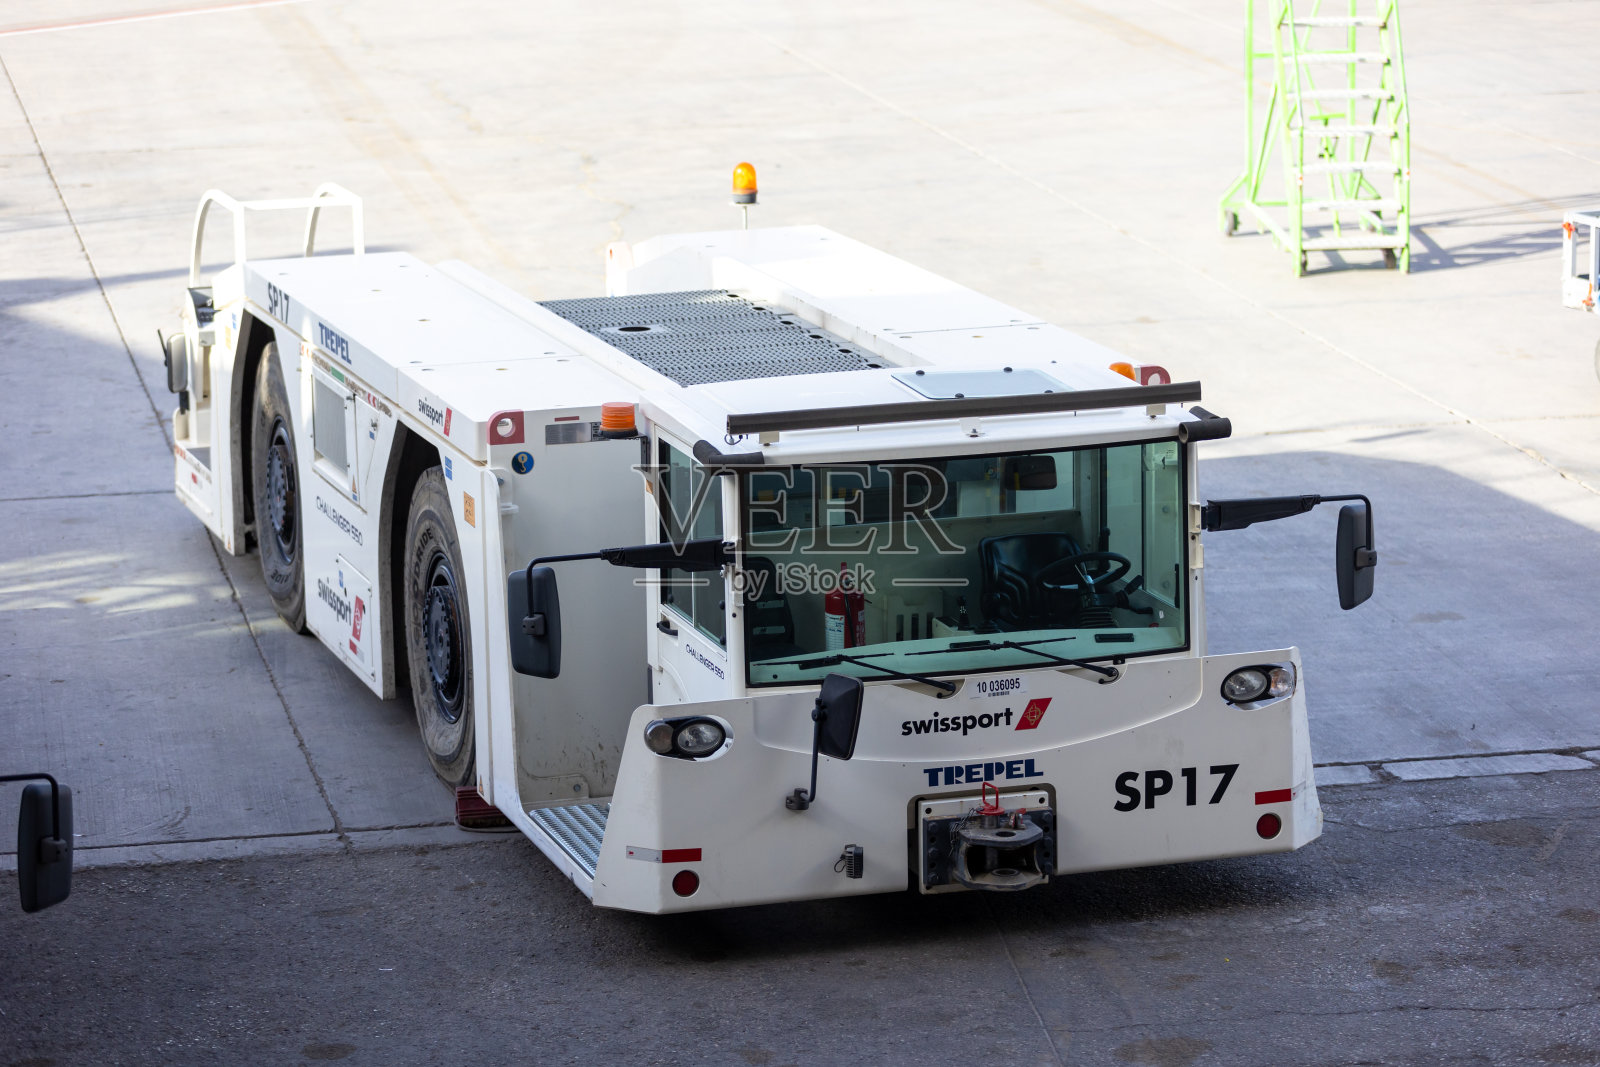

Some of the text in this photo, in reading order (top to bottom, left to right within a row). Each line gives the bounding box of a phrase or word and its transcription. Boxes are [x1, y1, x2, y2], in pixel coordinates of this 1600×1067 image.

[267, 281, 290, 325] SP17
[318, 321, 352, 365] TREPEL
[418, 397, 444, 427] swissport
[316, 495, 364, 547] CHALLENGER 550
[317, 576, 352, 627] swissport
[686, 643, 725, 680] CHALLENGER 550
[976, 677, 1021, 694] 10 036095
[901, 707, 1013, 736] swissport
[923, 758, 1044, 788] TREPEL
[1114, 764, 1240, 812] SP17
